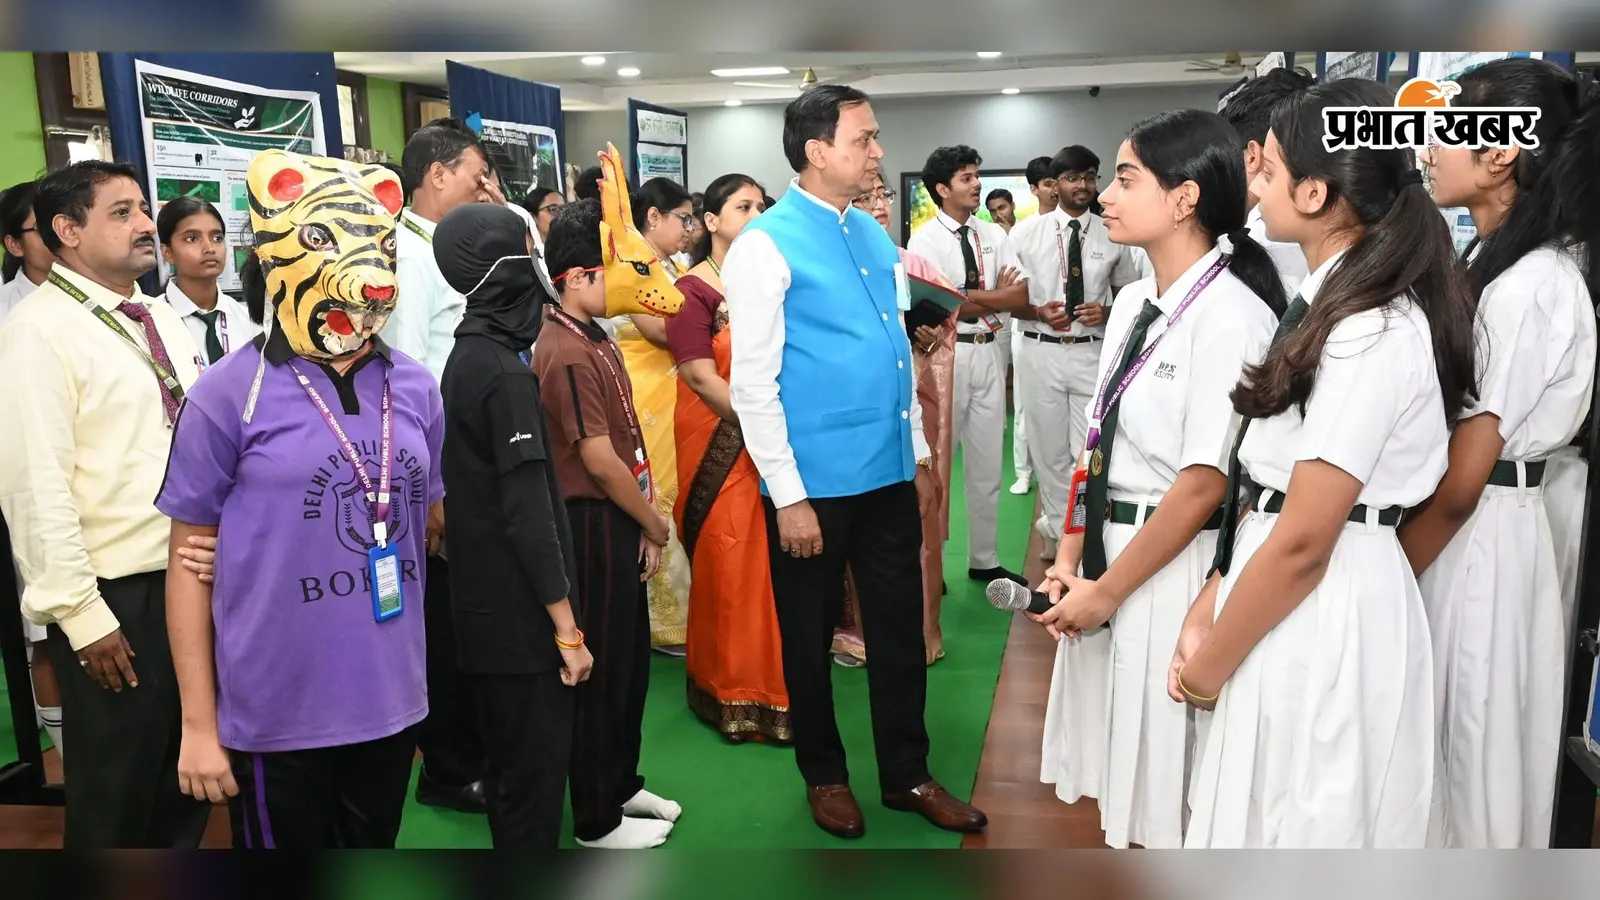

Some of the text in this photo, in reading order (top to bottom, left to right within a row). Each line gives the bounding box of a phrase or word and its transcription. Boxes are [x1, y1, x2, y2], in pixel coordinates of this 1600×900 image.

[147, 82, 189, 99] WILDLIFE
[189, 91, 239, 108] CORRIDORS
[70, 288, 85, 301] DELHI
[100, 313, 121, 332] BOKARO
[1109, 384, 1124, 406] PUBLIC
[1121, 359, 1143, 387] SCHOOL,
[308, 386, 330, 414] BOKARO
[621, 395, 630, 413] PUBLIC
[345, 442, 362, 468] PUBLIC
[303, 467, 333, 520] DELHI
[327, 439, 378, 470] PUBLI
[358, 467, 372, 489] DELHI
[298, 559, 419, 604] BOKR
